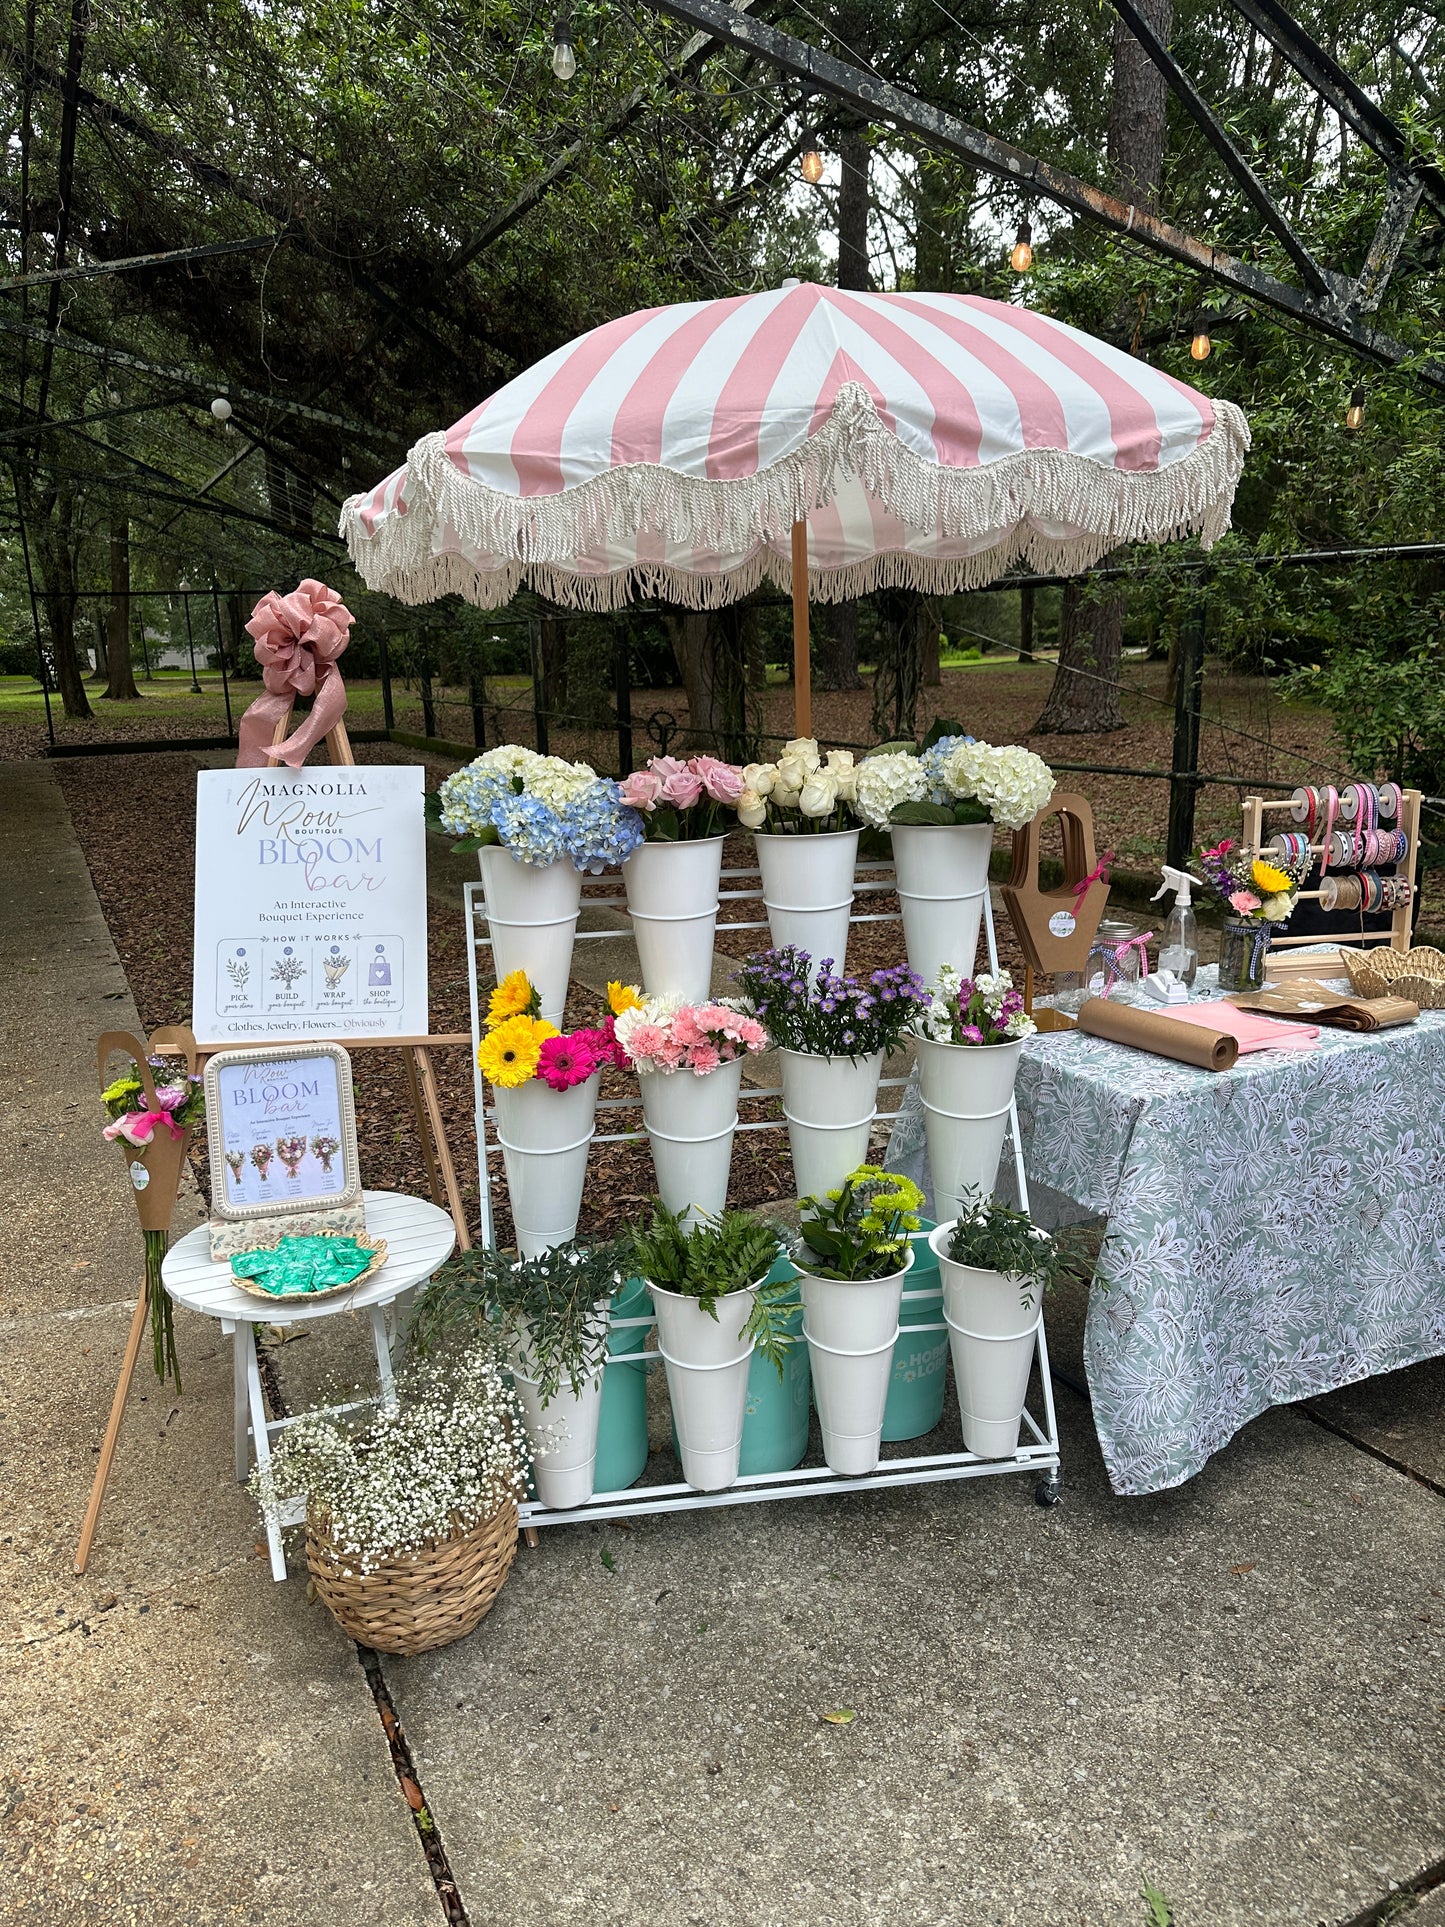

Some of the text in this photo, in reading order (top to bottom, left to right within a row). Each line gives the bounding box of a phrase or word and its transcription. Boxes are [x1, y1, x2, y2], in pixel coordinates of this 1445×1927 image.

[262, 783, 368, 797] MAGNOLIA
[258, 838, 383, 865] BLOOM
[305, 851, 386, 891] bar
[273, 900, 347, 910] An Interactive
[259, 912, 364, 923] Bouquet Experience
[315, 934, 350, 942] WORKS
[227, 1021, 265, 1032] Clothes,
[266, 1020, 301, 1031] Jewelry,
[233, 1080, 320, 1106] BLOOM
[264, 1094, 308, 1115] bar
